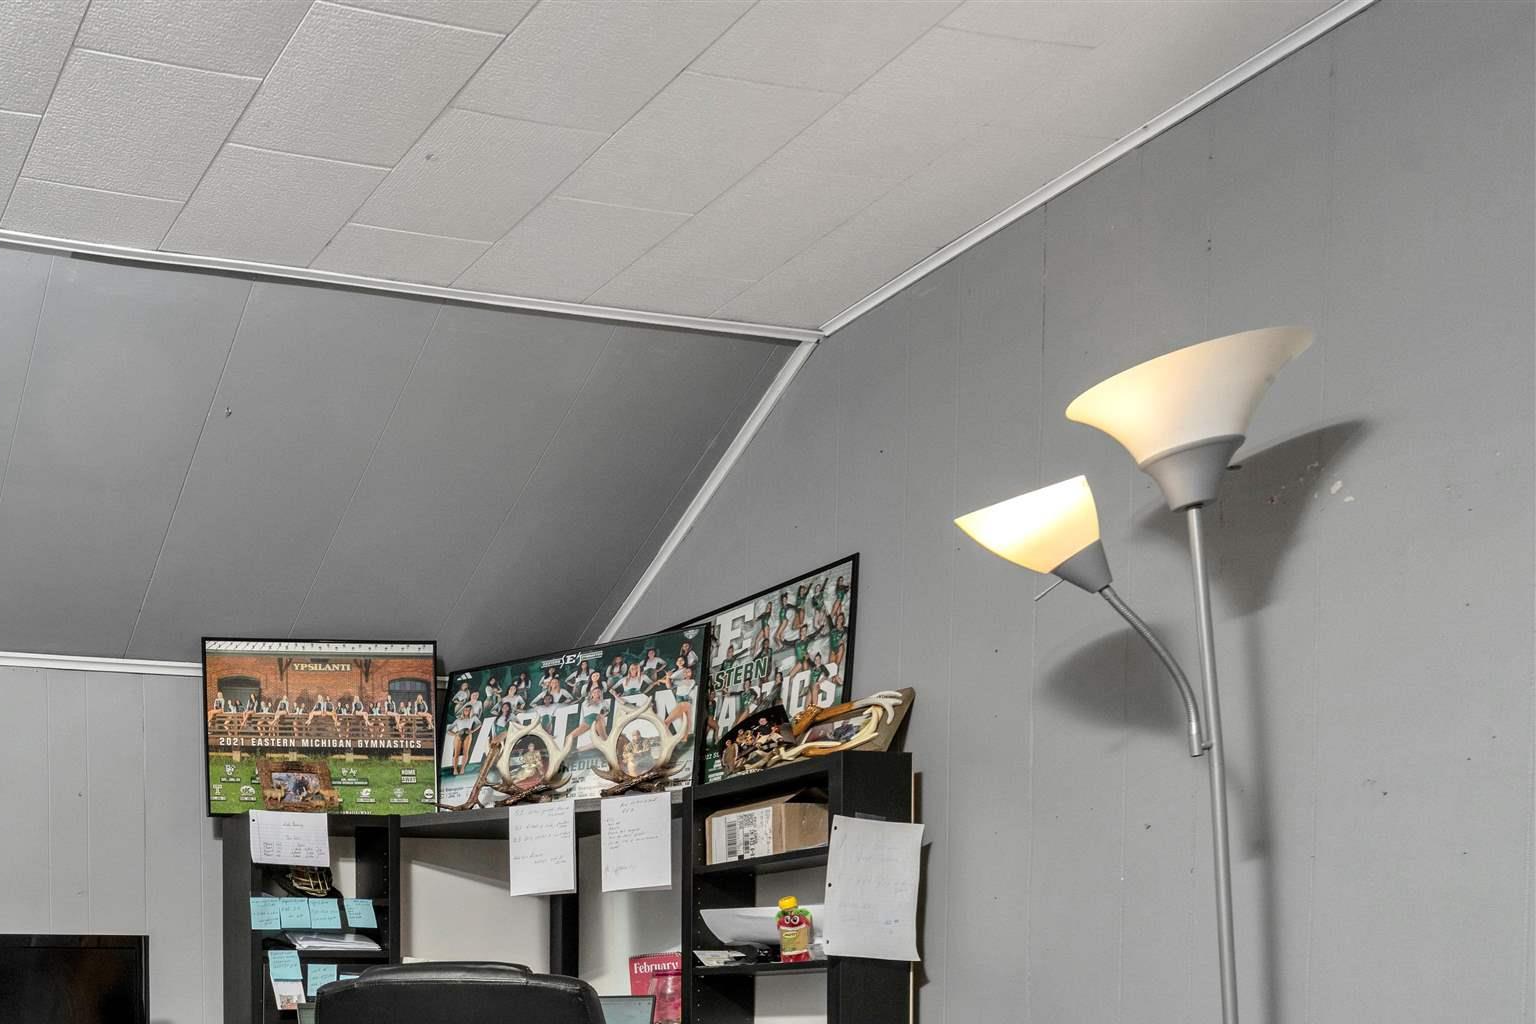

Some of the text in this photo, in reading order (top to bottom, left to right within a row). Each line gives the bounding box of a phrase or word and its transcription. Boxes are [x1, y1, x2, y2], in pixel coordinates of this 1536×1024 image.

[293, 663, 351, 671] YPSILANTI
[219, 737, 422, 749] 2021 EASTERN MICHIGAN GYMNASTICS
[633, 960, 679, 975] February
